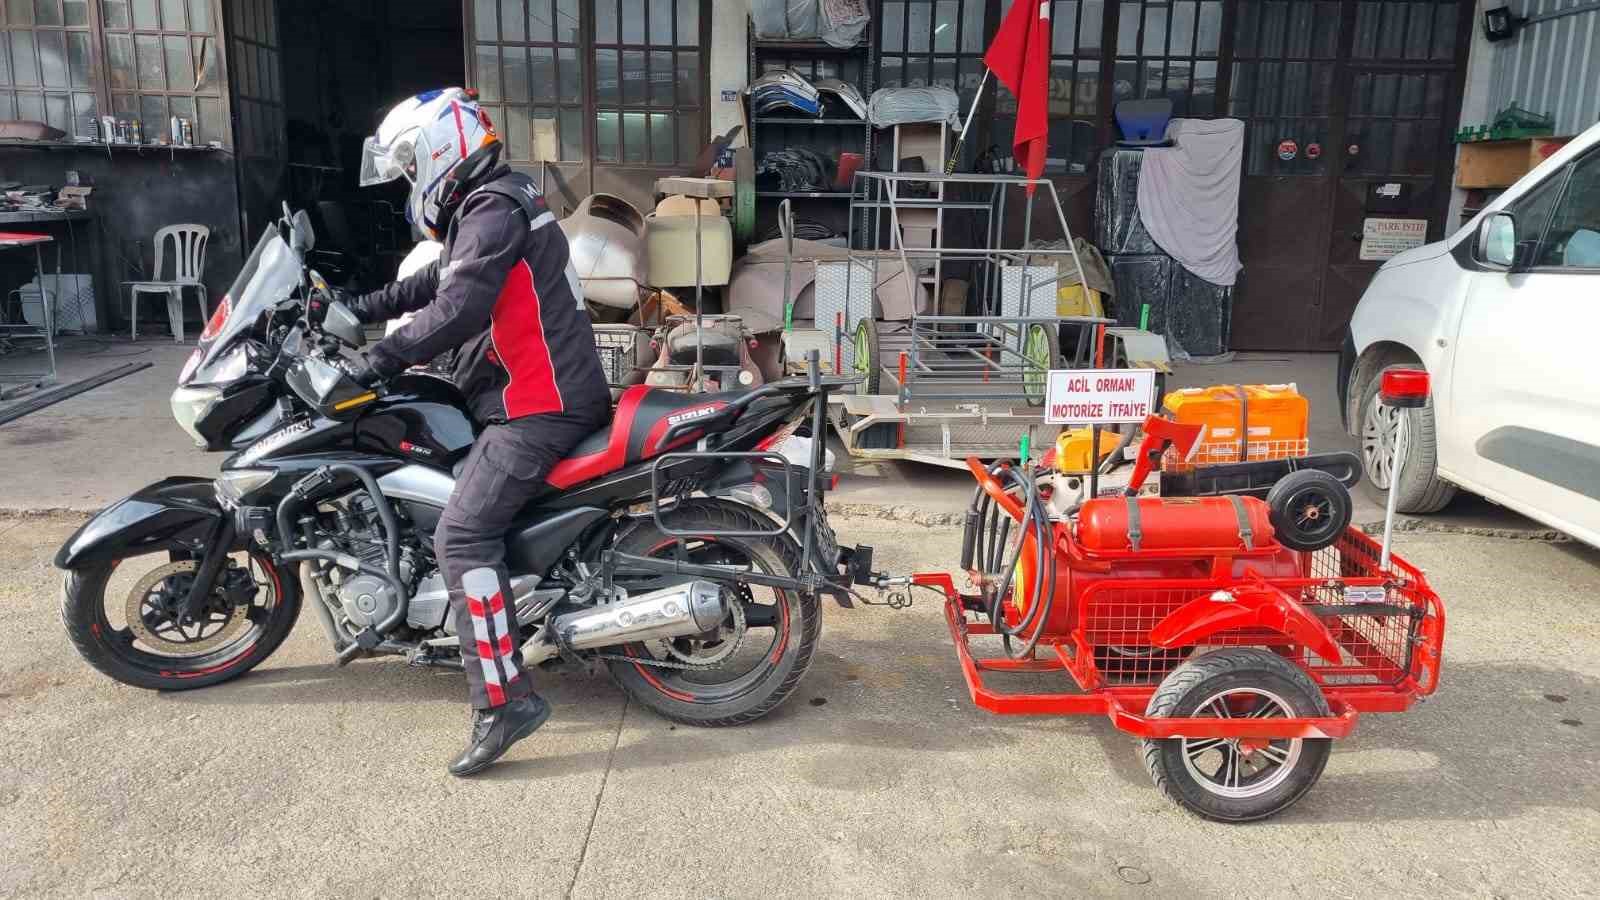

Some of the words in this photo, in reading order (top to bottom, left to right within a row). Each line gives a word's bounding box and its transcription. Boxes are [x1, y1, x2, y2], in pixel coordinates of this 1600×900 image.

[1067, 376, 1090, 393] ACİL
[1096, 378, 1135, 392] ORMAN!
[668, 407, 715, 425] SUZUKI
[1052, 400, 1103, 418] MOTORİZE
[1109, 400, 1147, 417] İTFAİYE
